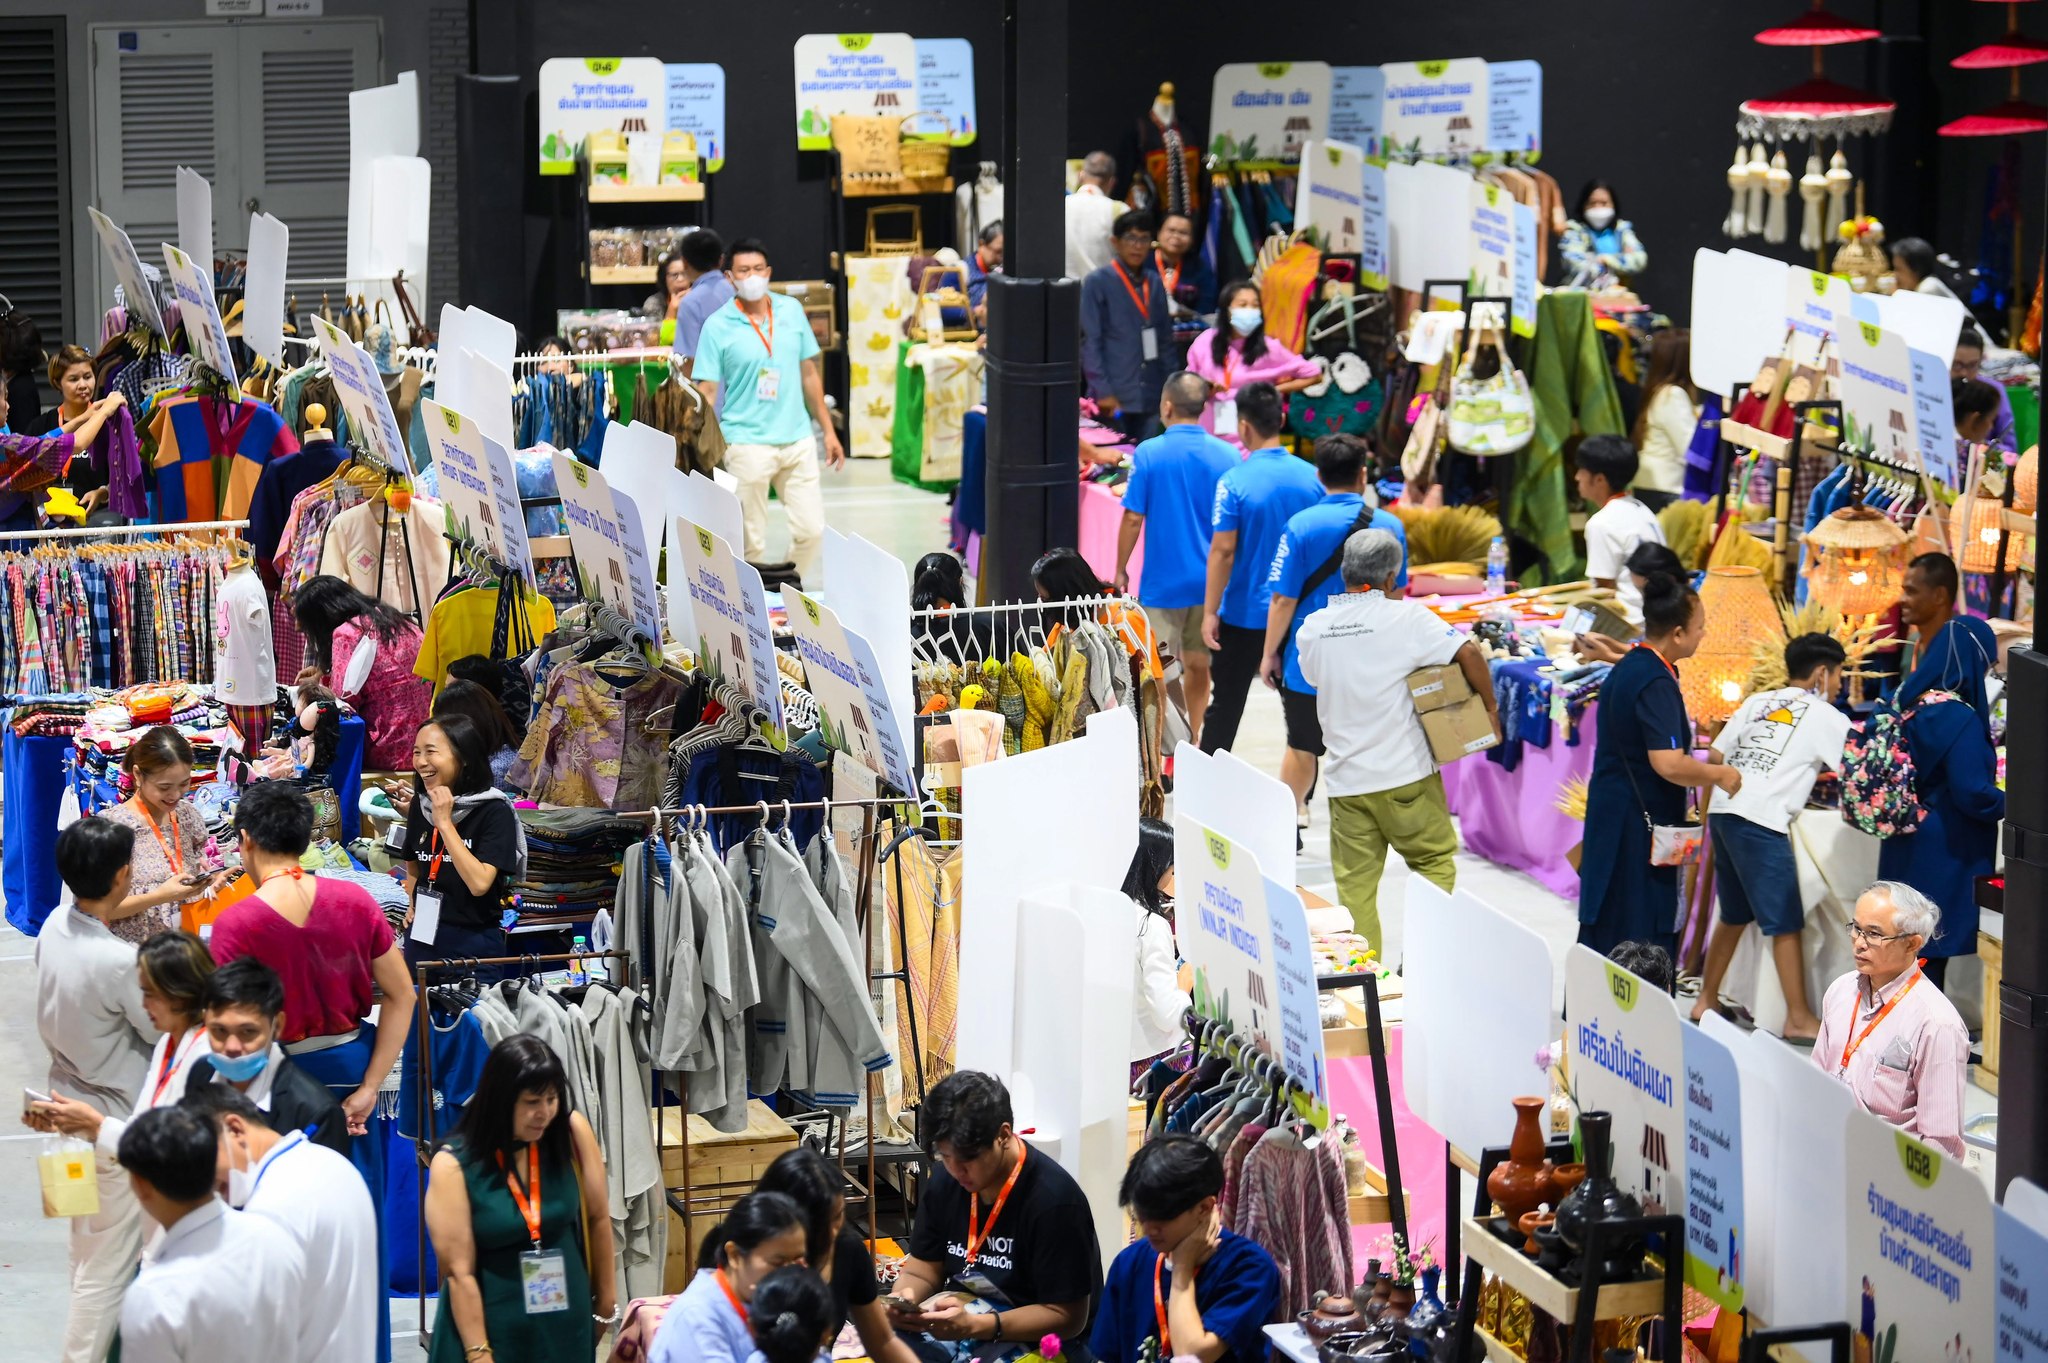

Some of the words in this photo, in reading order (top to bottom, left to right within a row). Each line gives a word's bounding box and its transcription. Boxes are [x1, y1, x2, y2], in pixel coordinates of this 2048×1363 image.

[1197, 901, 1228, 942] (NINJA
[1229, 922, 1262, 964] INDIGO)
[1613, 974, 1631, 1003] 057
[1578, 1017, 1673, 1108] เครื่องปั้นดินเผา
[1688, 1085, 1714, 1113] เชียงใหม่
[1906, 1144, 1931, 1180] 058
[987, 1236, 1014, 1254] NOT
